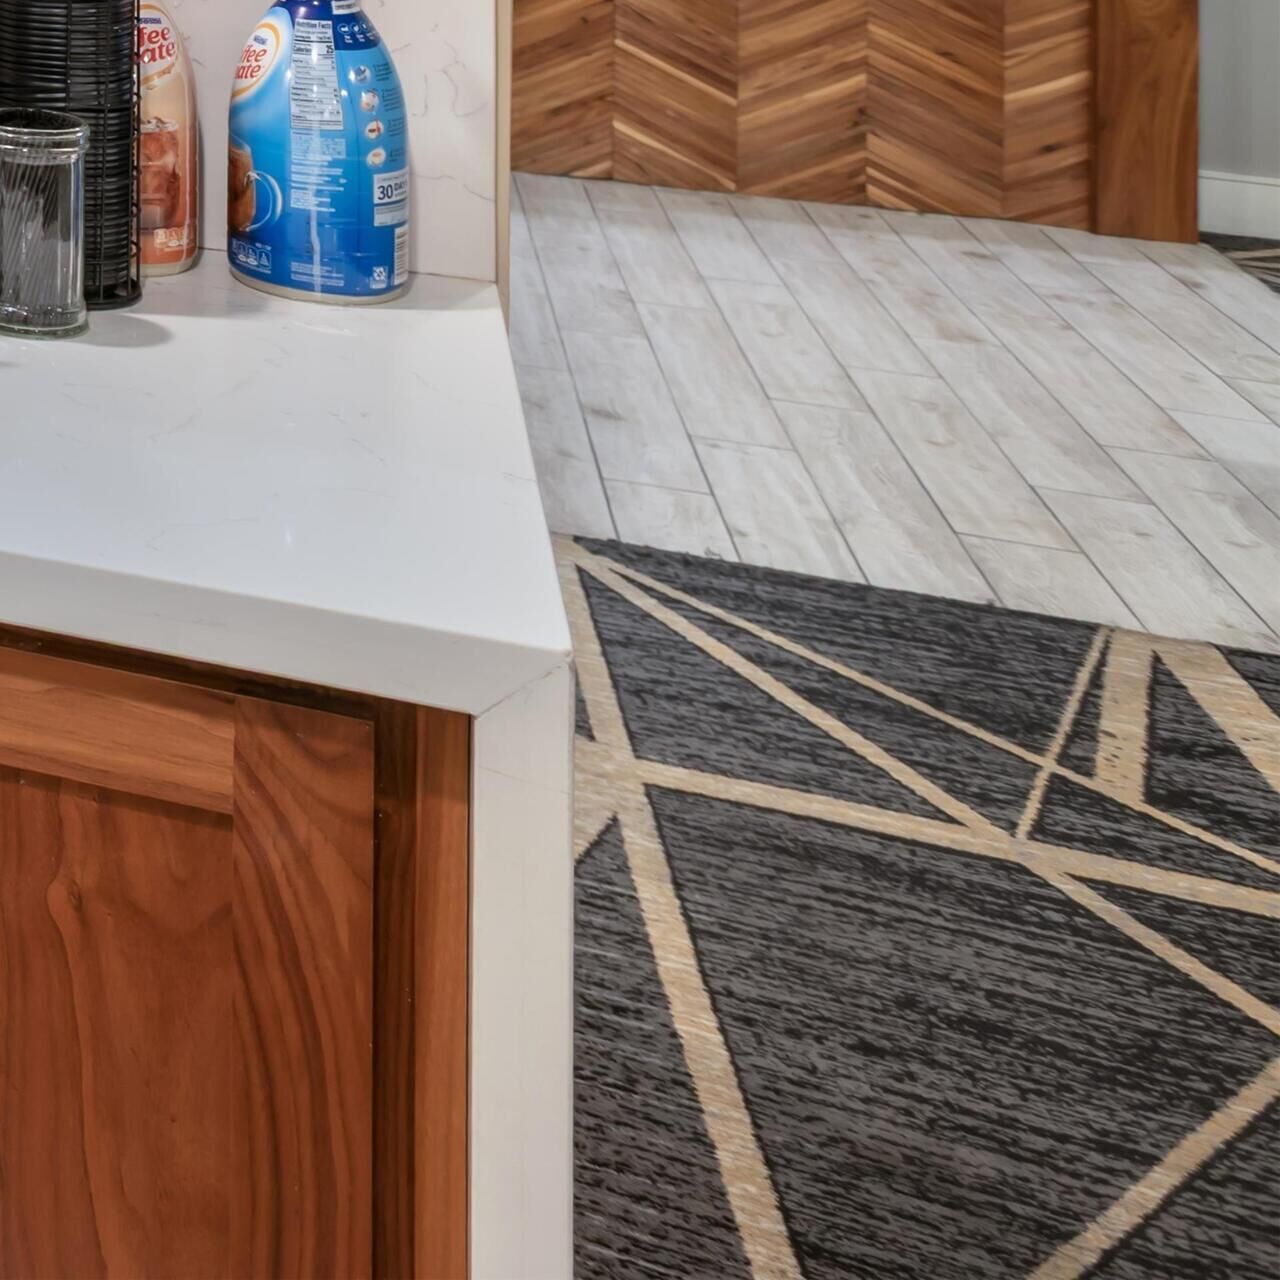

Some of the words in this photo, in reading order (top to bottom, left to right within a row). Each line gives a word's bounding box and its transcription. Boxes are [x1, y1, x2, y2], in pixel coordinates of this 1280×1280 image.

[141, 41, 176, 65] ate
[325, 44, 334, 54] 25
[377, 183, 394, 201] 30
